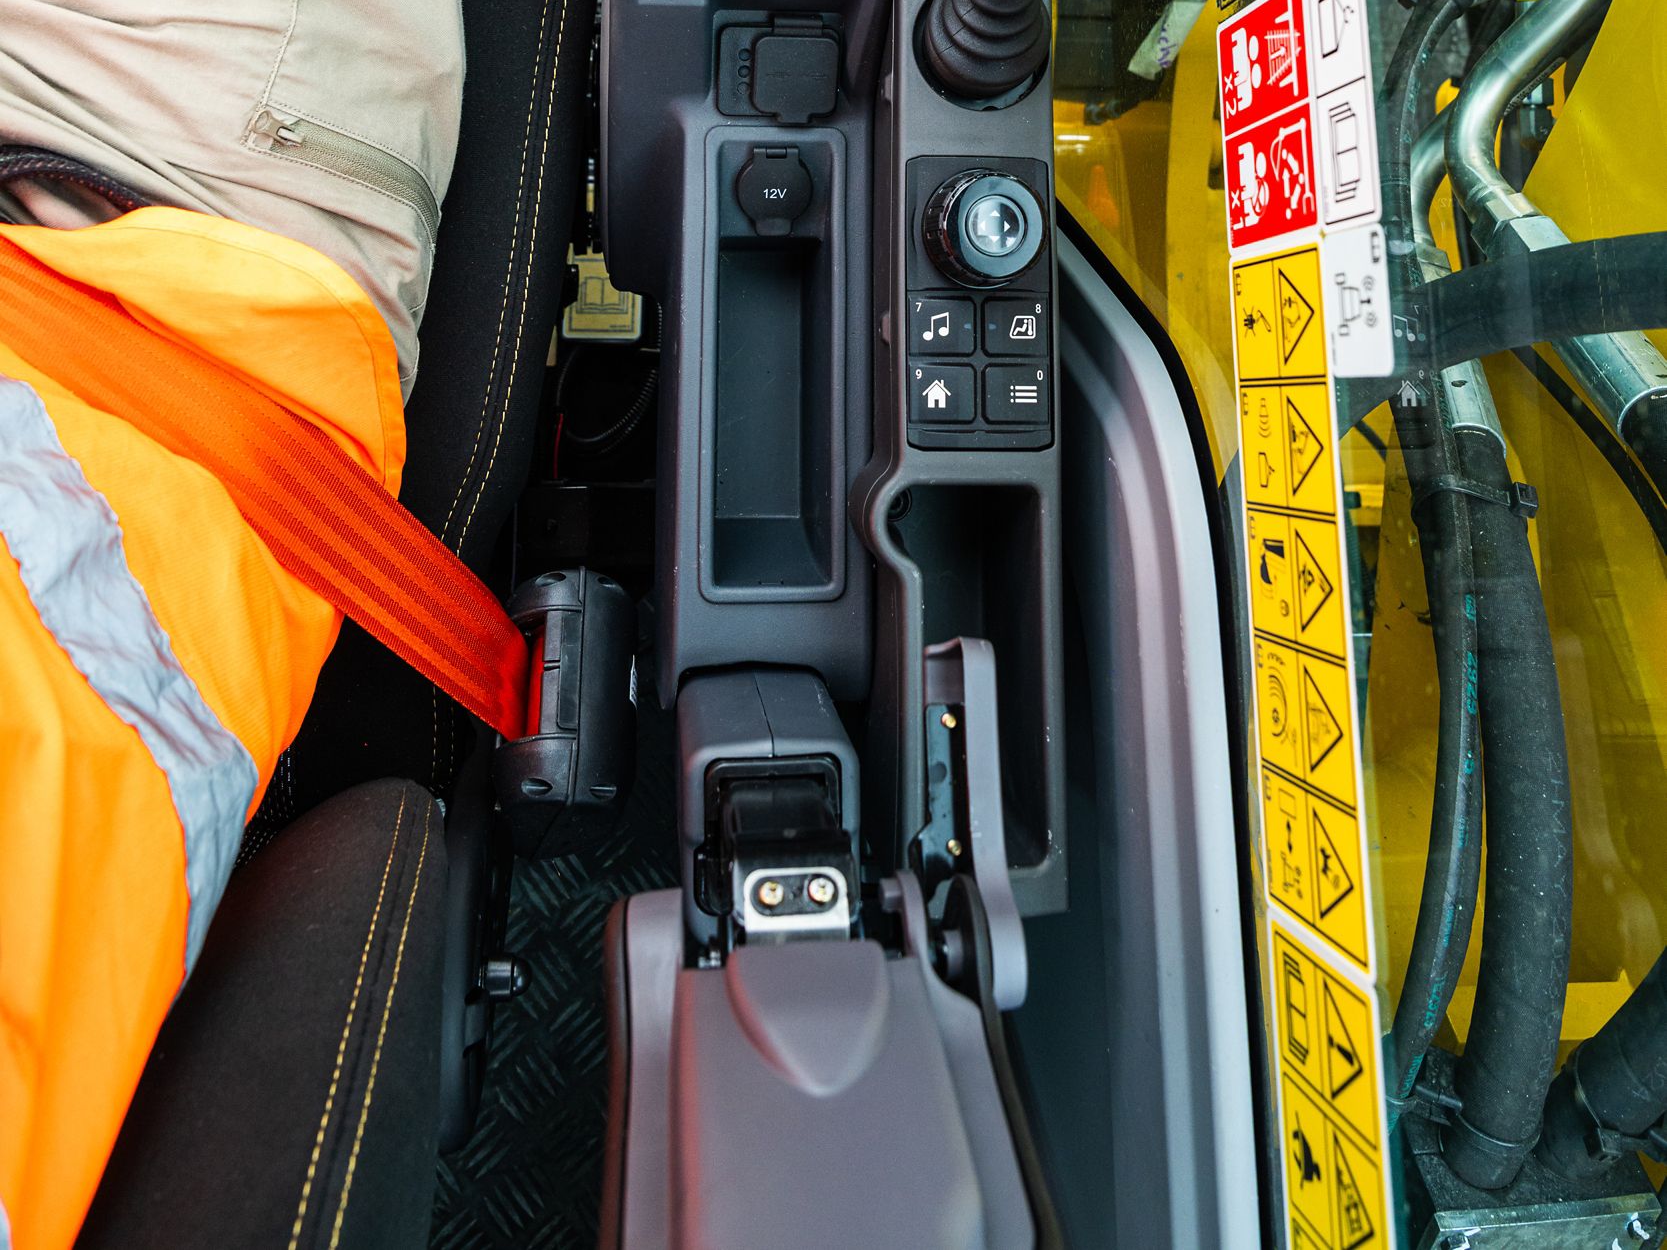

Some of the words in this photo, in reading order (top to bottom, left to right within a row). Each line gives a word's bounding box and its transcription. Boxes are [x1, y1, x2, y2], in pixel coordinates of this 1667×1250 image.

[763, 188, 788, 200] 12V
[915, 302, 922, 312] 7
[1035, 303, 1042, 314] 8
[915, 369, 922, 380] 9
[1036, 370, 1043, 381] 0
